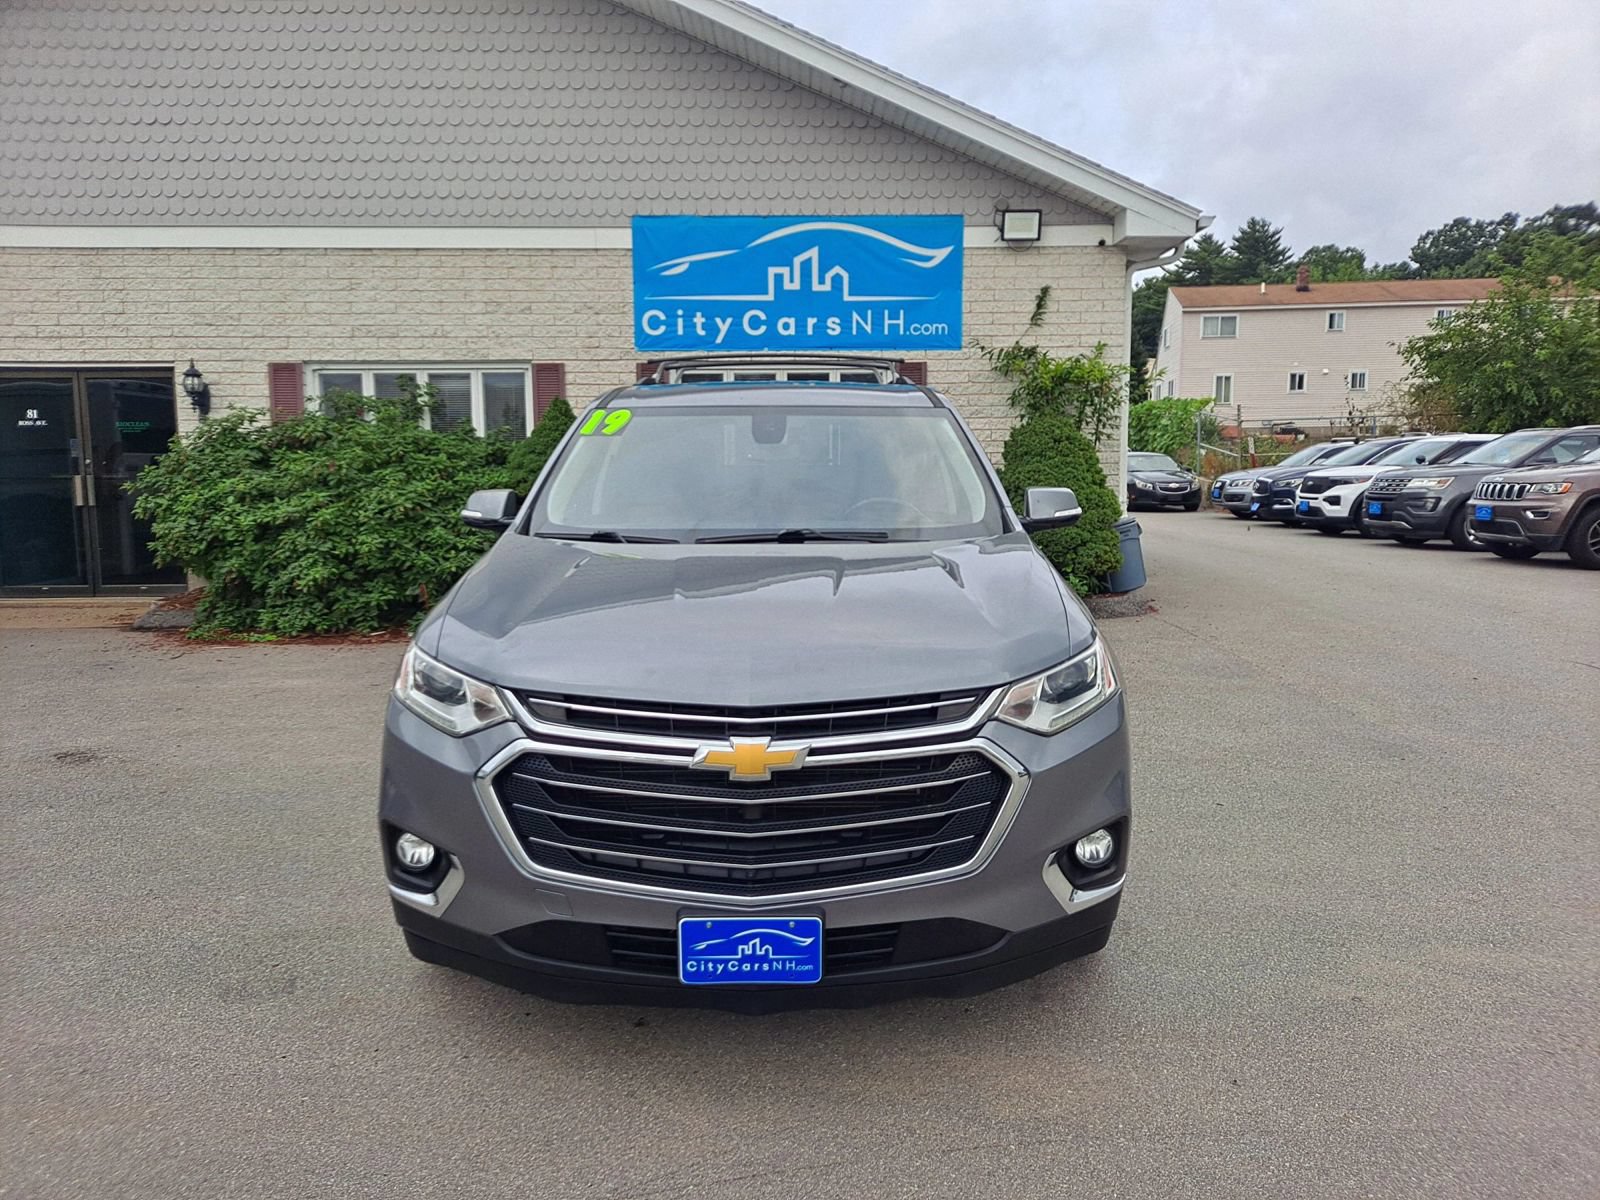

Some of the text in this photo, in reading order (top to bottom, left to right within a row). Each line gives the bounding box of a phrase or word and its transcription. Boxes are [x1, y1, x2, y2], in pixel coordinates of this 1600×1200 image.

[642, 309, 948, 343] CityCarsNH.com
[26, 408, 38, 419] 81
[580, 409, 632, 435] 19
